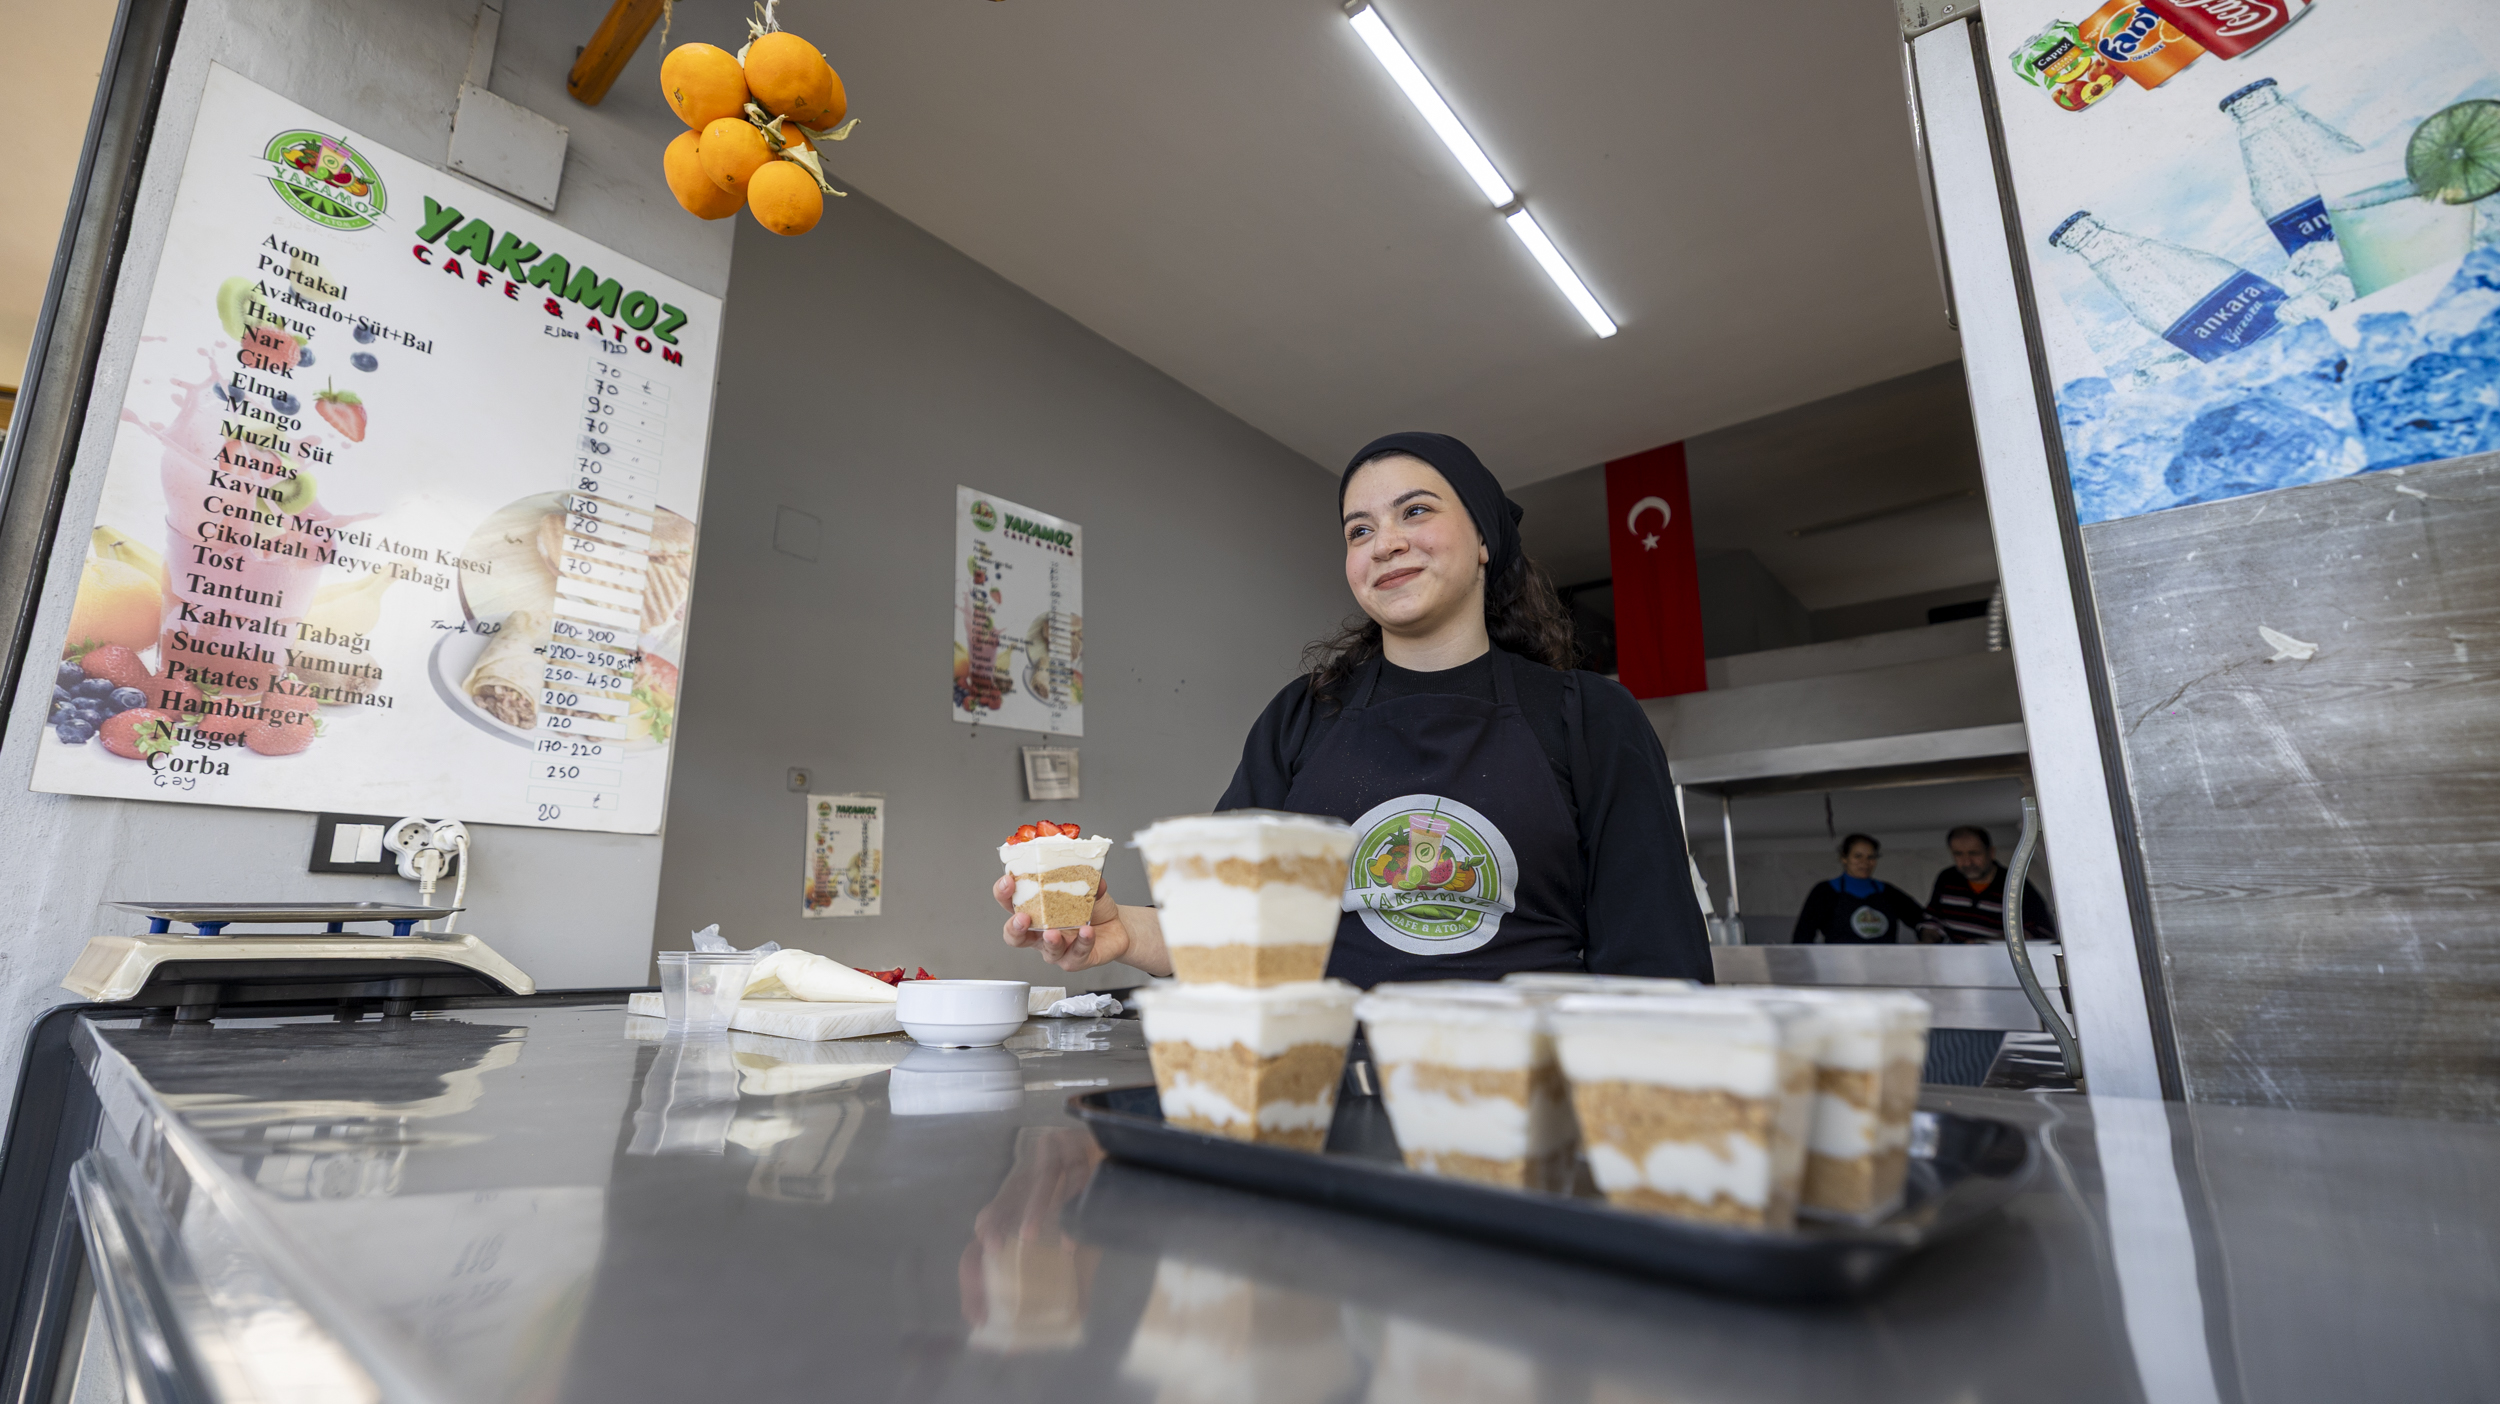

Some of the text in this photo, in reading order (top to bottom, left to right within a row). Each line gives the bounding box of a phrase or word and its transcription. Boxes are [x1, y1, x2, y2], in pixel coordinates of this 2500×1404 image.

[2131, 43, 2166, 62] ORANGE
[273, 165, 381, 221] YAKAMOZ
[262, 234, 320, 267] Atom
[256, 253, 348, 301] Portakal
[415, 195, 688, 346] YAKAMOZ
[247, 301, 316, 340] Havuç
[251, 280, 434, 354] Avakado+Süt+Bal
[412, 244, 684, 367] CAFE & ATOM
[2194, 285, 2261, 339] ankara
[241, 323, 284, 350] Nar
[237, 349, 294, 380] Çilek
[597, 361, 621, 378] 70
[232, 371, 288, 403] Elma
[594, 378, 619, 395] 70
[225, 396, 302, 432] Mango
[588, 396, 614, 416] 90
[584, 417, 609, 434] 70
[219, 420, 334, 465] Muzlu Süt
[213, 446, 298, 481] Ananas
[578, 457, 602, 474] 70
[208, 469, 284, 503] Kavun
[578, 477, 599, 492] 80
[569, 497, 598, 514] 130
[203, 496, 493, 576] Cennet Meyveli Atom Kasesi
[572, 516, 598, 534] 70
[1004, 512, 1073, 548] YAKAMOZ
[192, 544, 245, 573] Tost
[197, 521, 450, 593] Çikolatalı Meyve Tabağı
[569, 537, 595, 553] 70
[567, 558, 592, 575] 70
[186, 573, 284, 609] Tantuni
[177, 602, 371, 655] Kahvaltı Tabağı
[476, 621, 502, 635] 120
[170, 630, 383, 681] Sucuklu Yumurta
[165, 660, 394, 709] Patates Kızartması
[545, 691, 578, 707] 200
[157, 690, 310, 728] Hamburger
[547, 716, 572, 729] 120
[152, 720, 248, 751] Nugget
[146, 751, 230, 775] Çorba
[547, 766, 580, 779] 250
[537, 803, 561, 821] 20
[1435, 923, 1468, 933] ATOM
